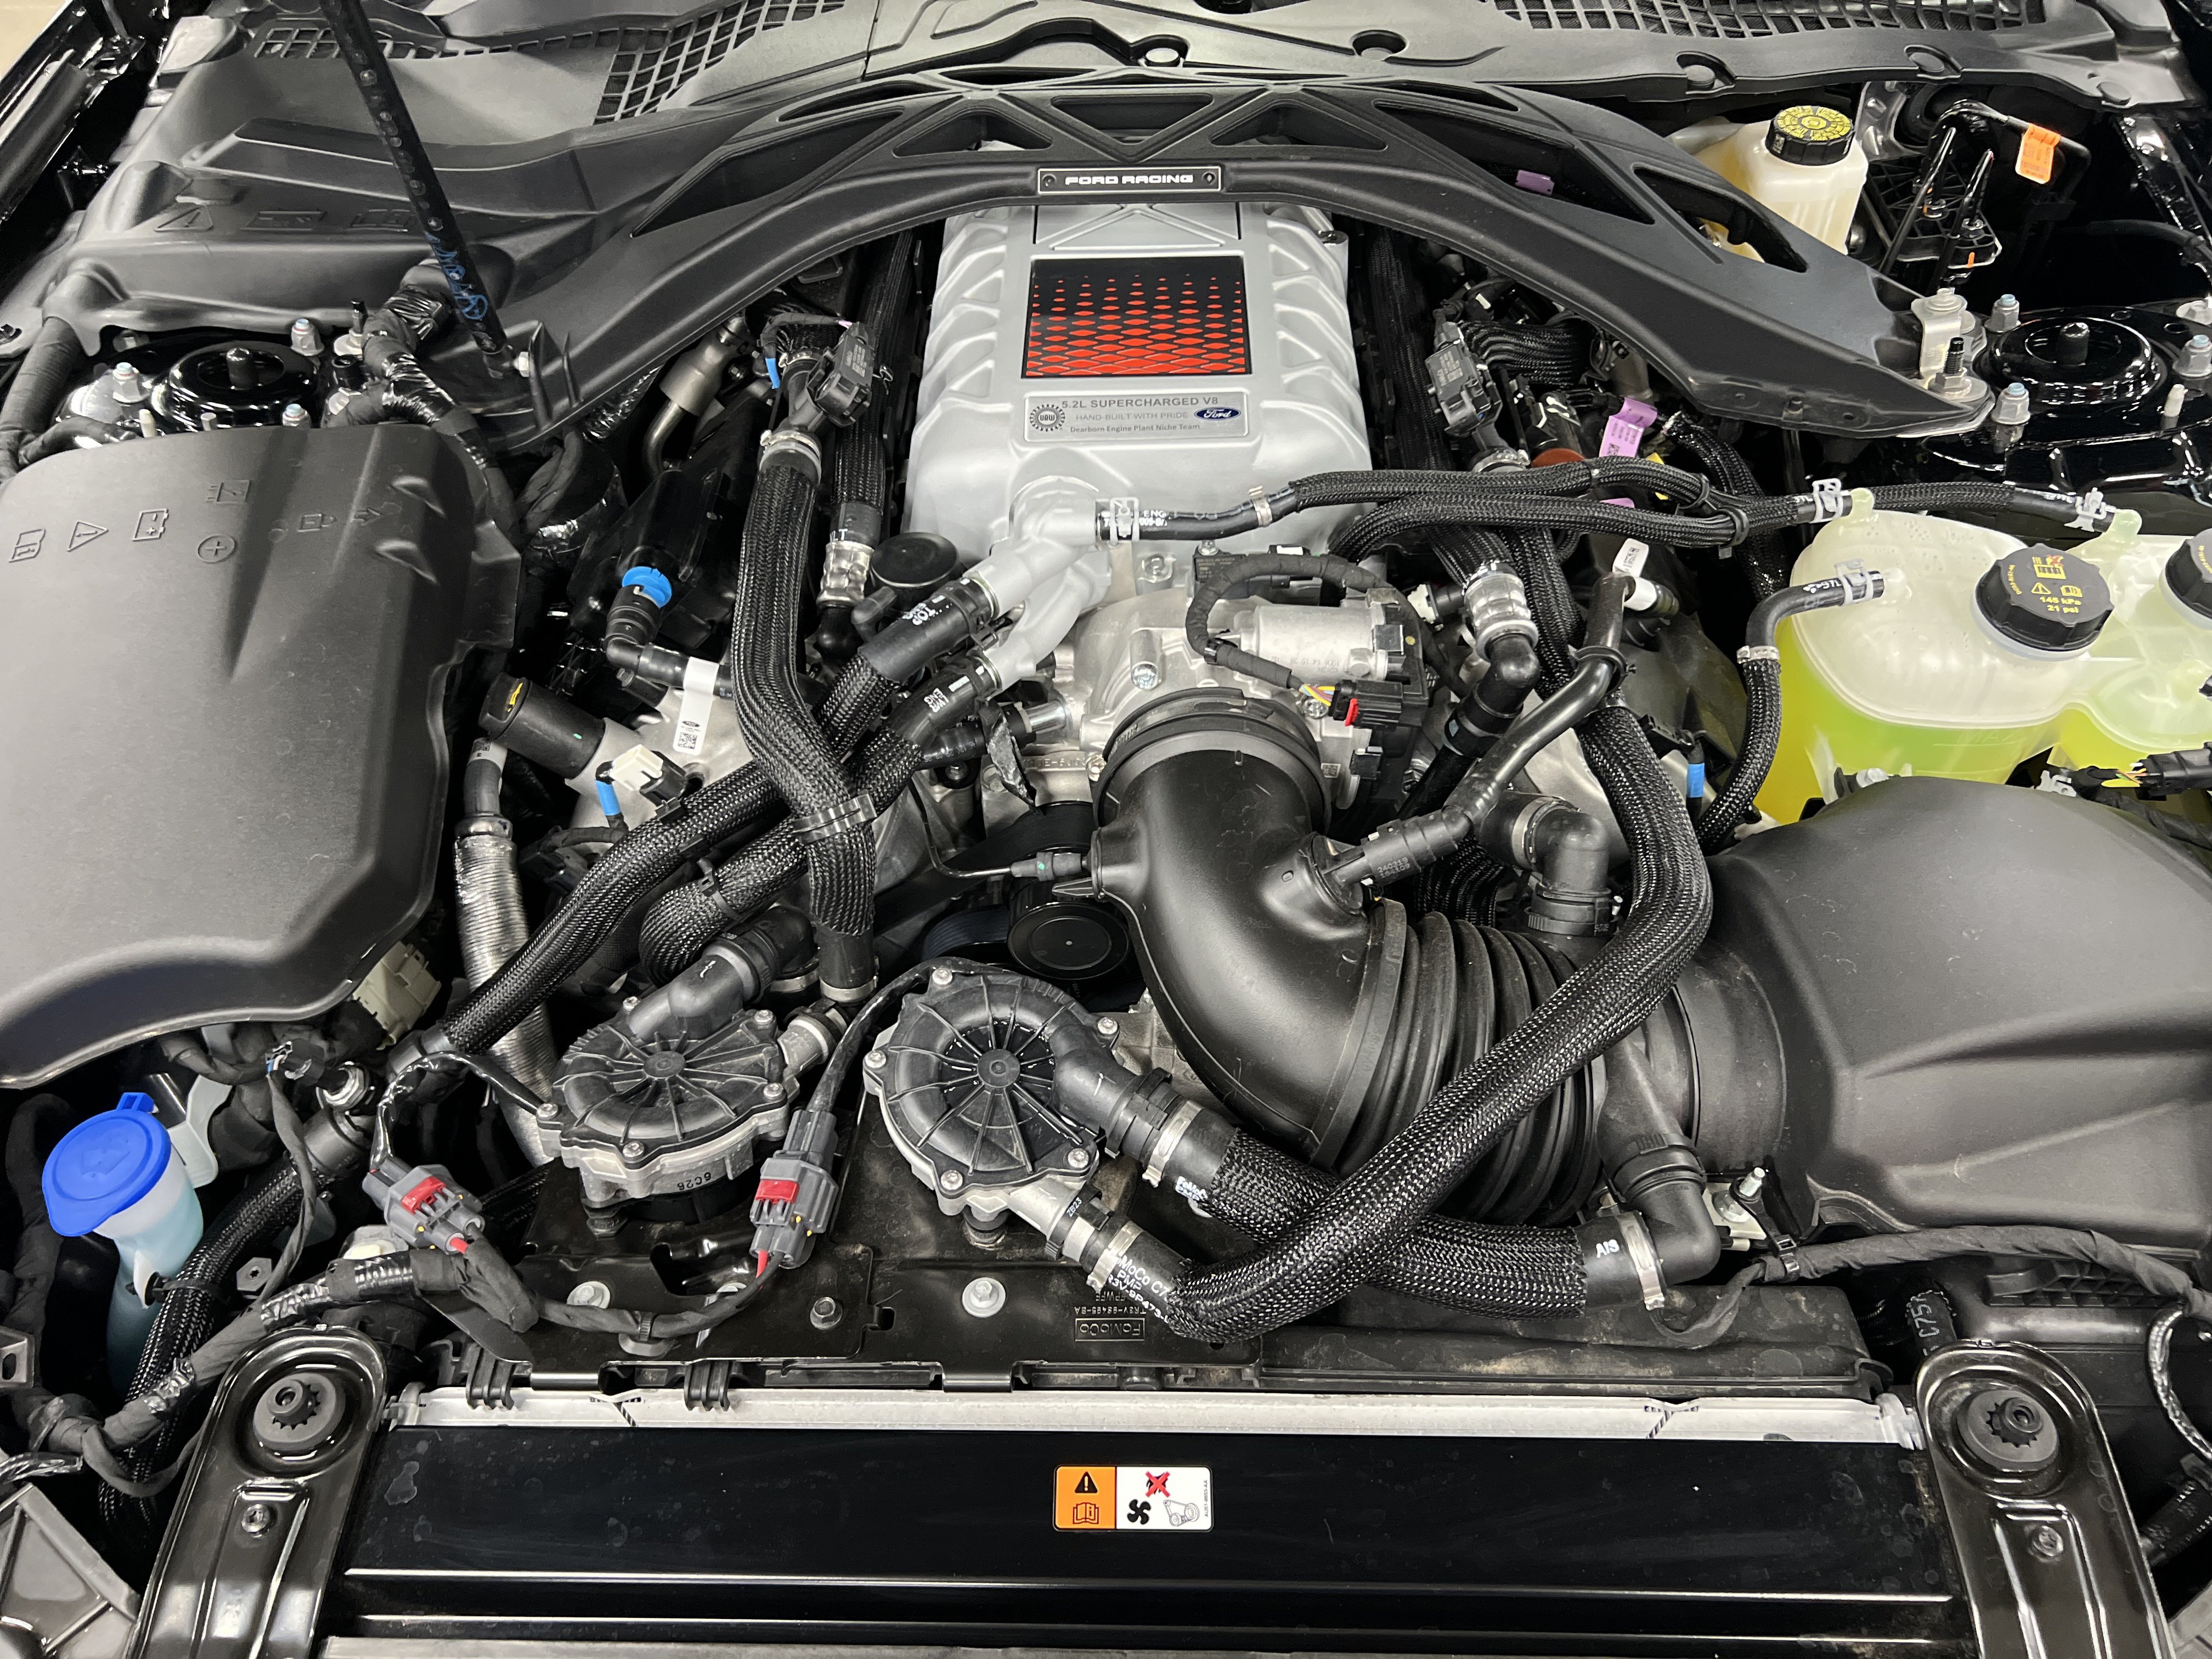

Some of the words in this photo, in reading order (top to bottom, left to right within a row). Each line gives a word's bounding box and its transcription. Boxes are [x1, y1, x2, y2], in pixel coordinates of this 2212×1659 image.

[1065, 176, 1119, 185] FORD
[1121, 174, 1193, 184] RACING
[1061, 400, 1087, 409] 5.2L
[1090, 397, 1199, 408] SUPERCHARGED
[1204, 397, 1218, 405] V8
[1076, 413, 1131, 421] HAND-BUILT
[1107, 425, 1132, 433] Engine
[2040, 596, 2059, 604] 145
[2061, 597, 2081, 606] kPa
[2047, 604, 2060, 612] 21
[1595, 1239, 1620, 1259] AIS
[1116, 1254, 1150, 1286] MoCo
[1117, 1269, 1143, 1290] PMP
[1079, 1323, 1141, 1336] FoMoCo
